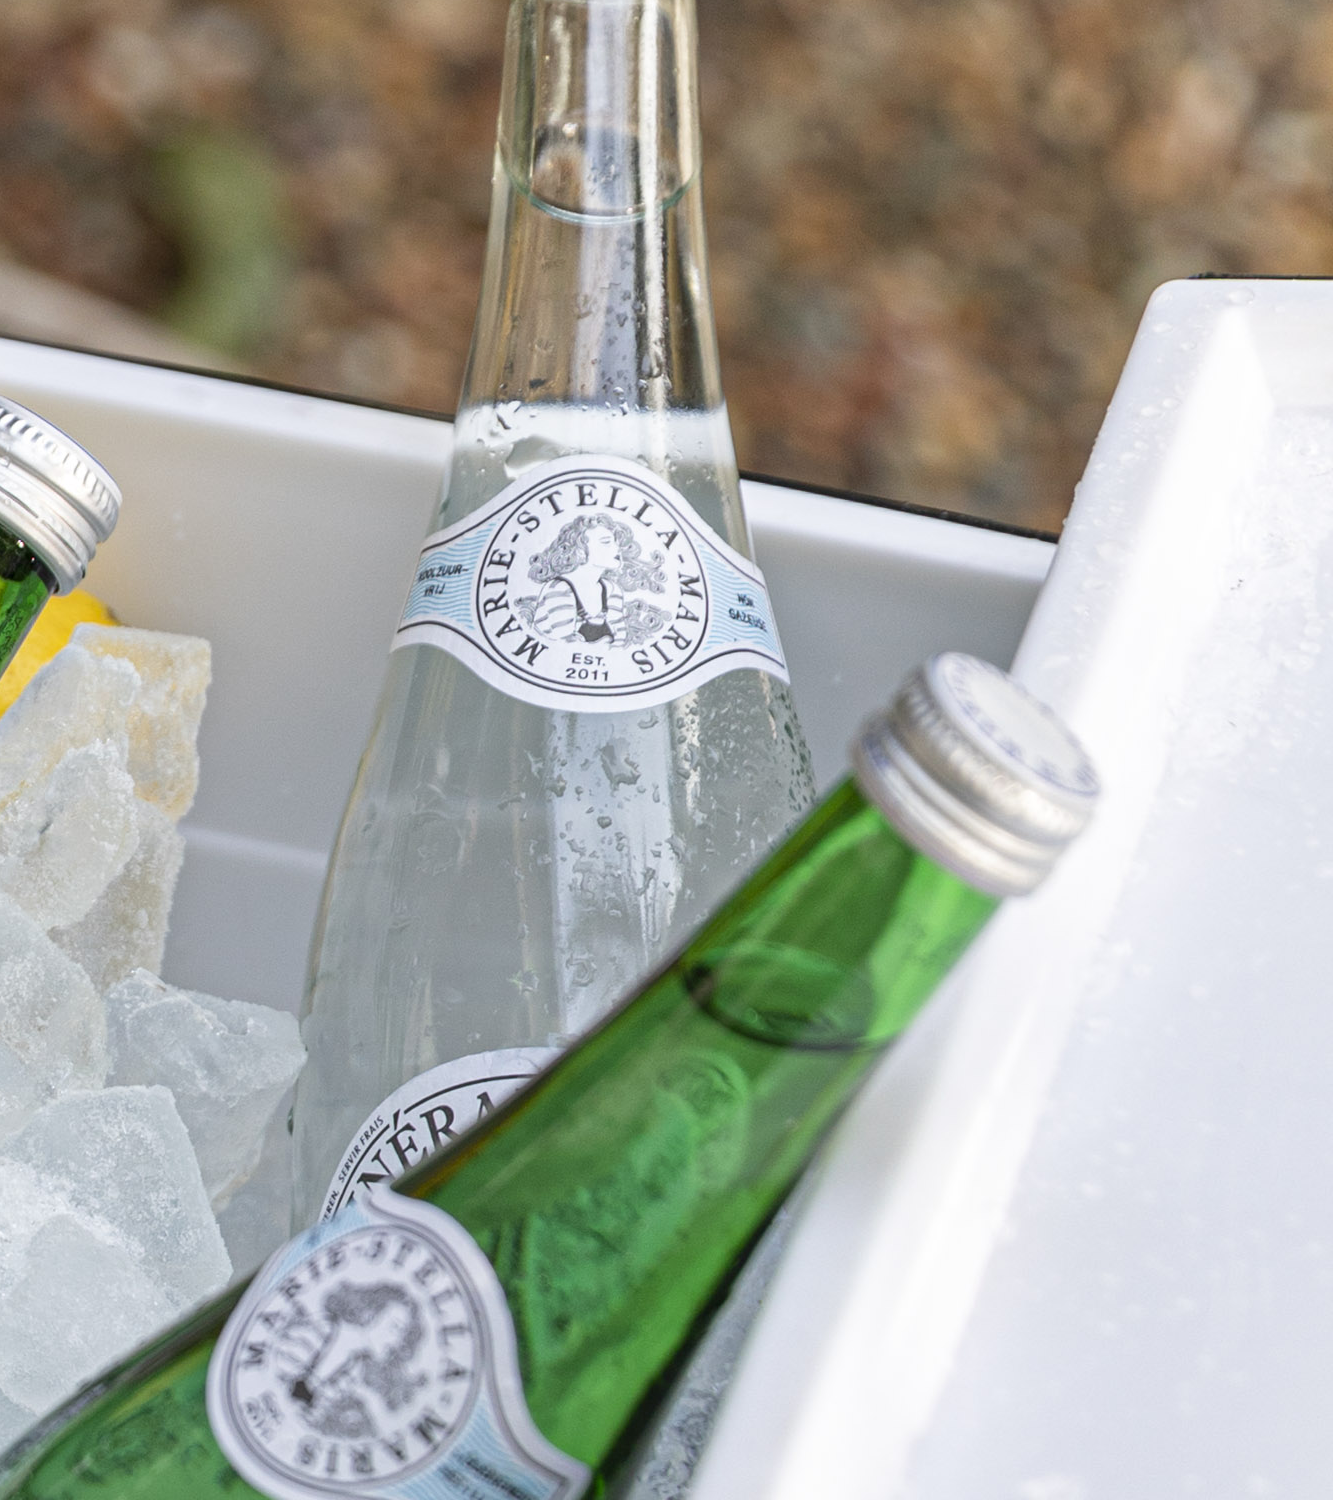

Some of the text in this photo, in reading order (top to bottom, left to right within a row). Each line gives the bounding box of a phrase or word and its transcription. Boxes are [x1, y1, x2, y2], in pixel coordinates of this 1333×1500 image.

[483, 483, 703, 675] MARIE-STELLA-MARIS
[564, 667, 610, 682] 2011
[337, 1144, 361, 1184] SERVIR
[359, 1114, 385, 1148] FRAIS
